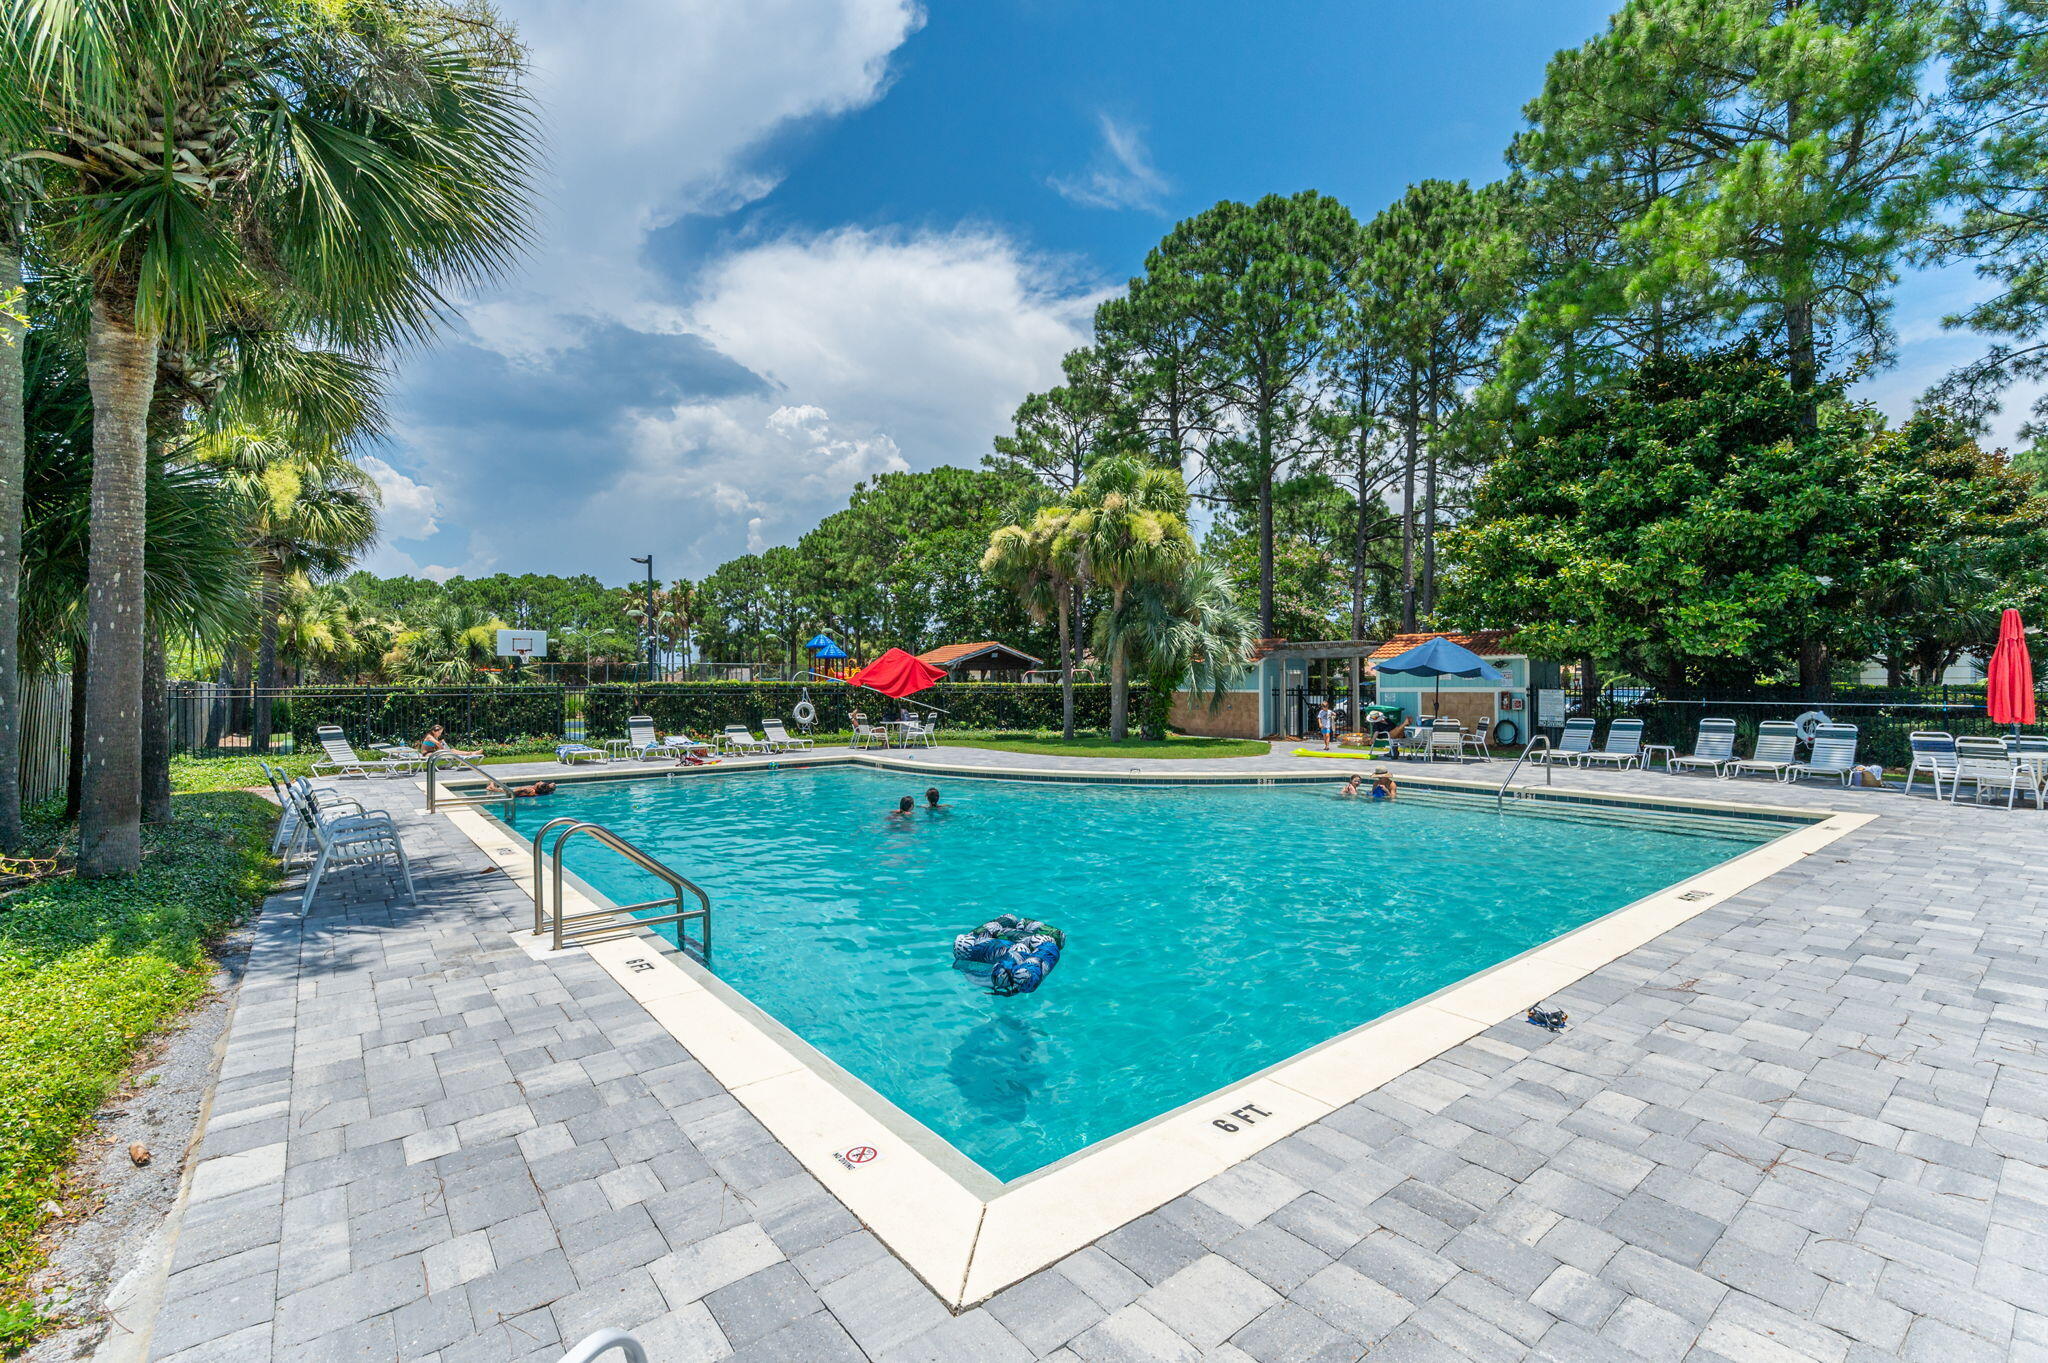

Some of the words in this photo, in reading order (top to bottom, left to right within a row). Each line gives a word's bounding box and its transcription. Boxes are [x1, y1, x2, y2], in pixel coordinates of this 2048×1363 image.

[1212, 1119, 1240, 1133] 6
[1230, 1103, 1273, 1125] FT.
[838, 1157, 856, 1171] DIVING
